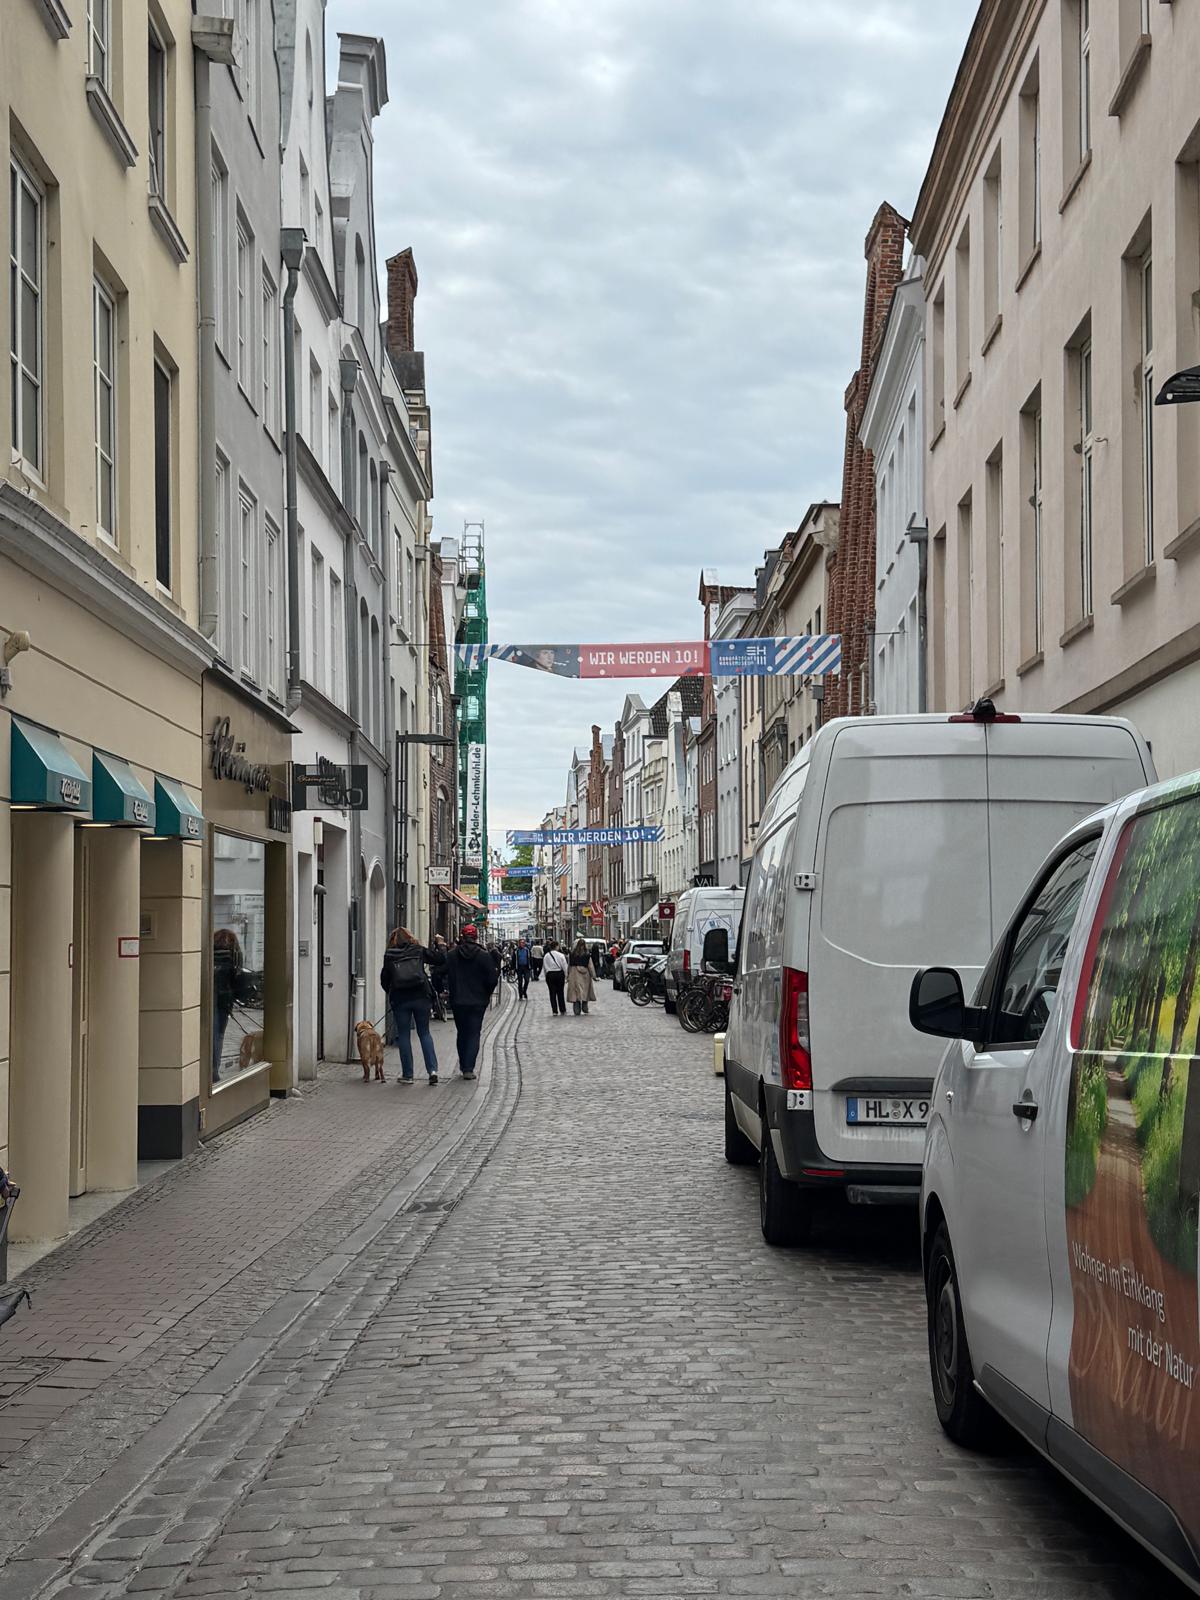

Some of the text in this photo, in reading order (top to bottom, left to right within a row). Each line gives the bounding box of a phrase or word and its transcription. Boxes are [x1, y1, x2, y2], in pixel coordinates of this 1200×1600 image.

[590, 649, 698, 665] WIR WERDEN 10!
[553, 832, 575, 843] WIR
[578, 831, 621, 842] WERDEN
[625, 830, 645, 840] 10!
[866, 1100, 889, 1118] HL
[903, 1101, 913, 1118] X
[1072, 1241, 1165, 1323] Wohnen im Einklang
[1127, 1325, 1194, 1390] mit der Natur
